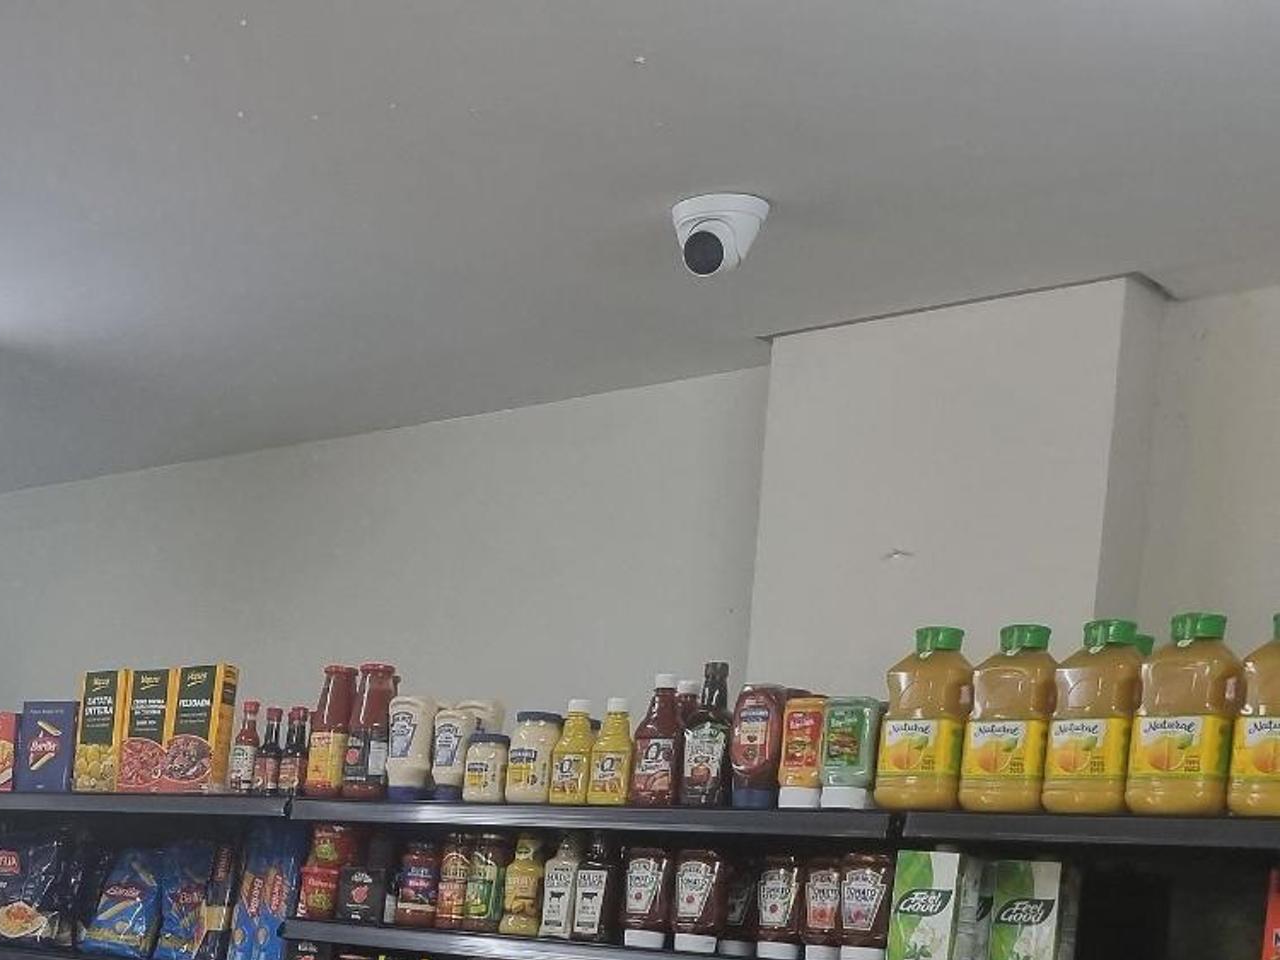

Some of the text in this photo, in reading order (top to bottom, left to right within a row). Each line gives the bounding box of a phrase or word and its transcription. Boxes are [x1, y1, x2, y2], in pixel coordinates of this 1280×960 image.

[1144, 719, 1197, 734] Natural
[912, 890, 941, 903] Feel
[899, 899, 942, 914] Good
[1013, 900, 1044, 914] Feel
[1001, 908, 1044, 924] Good
